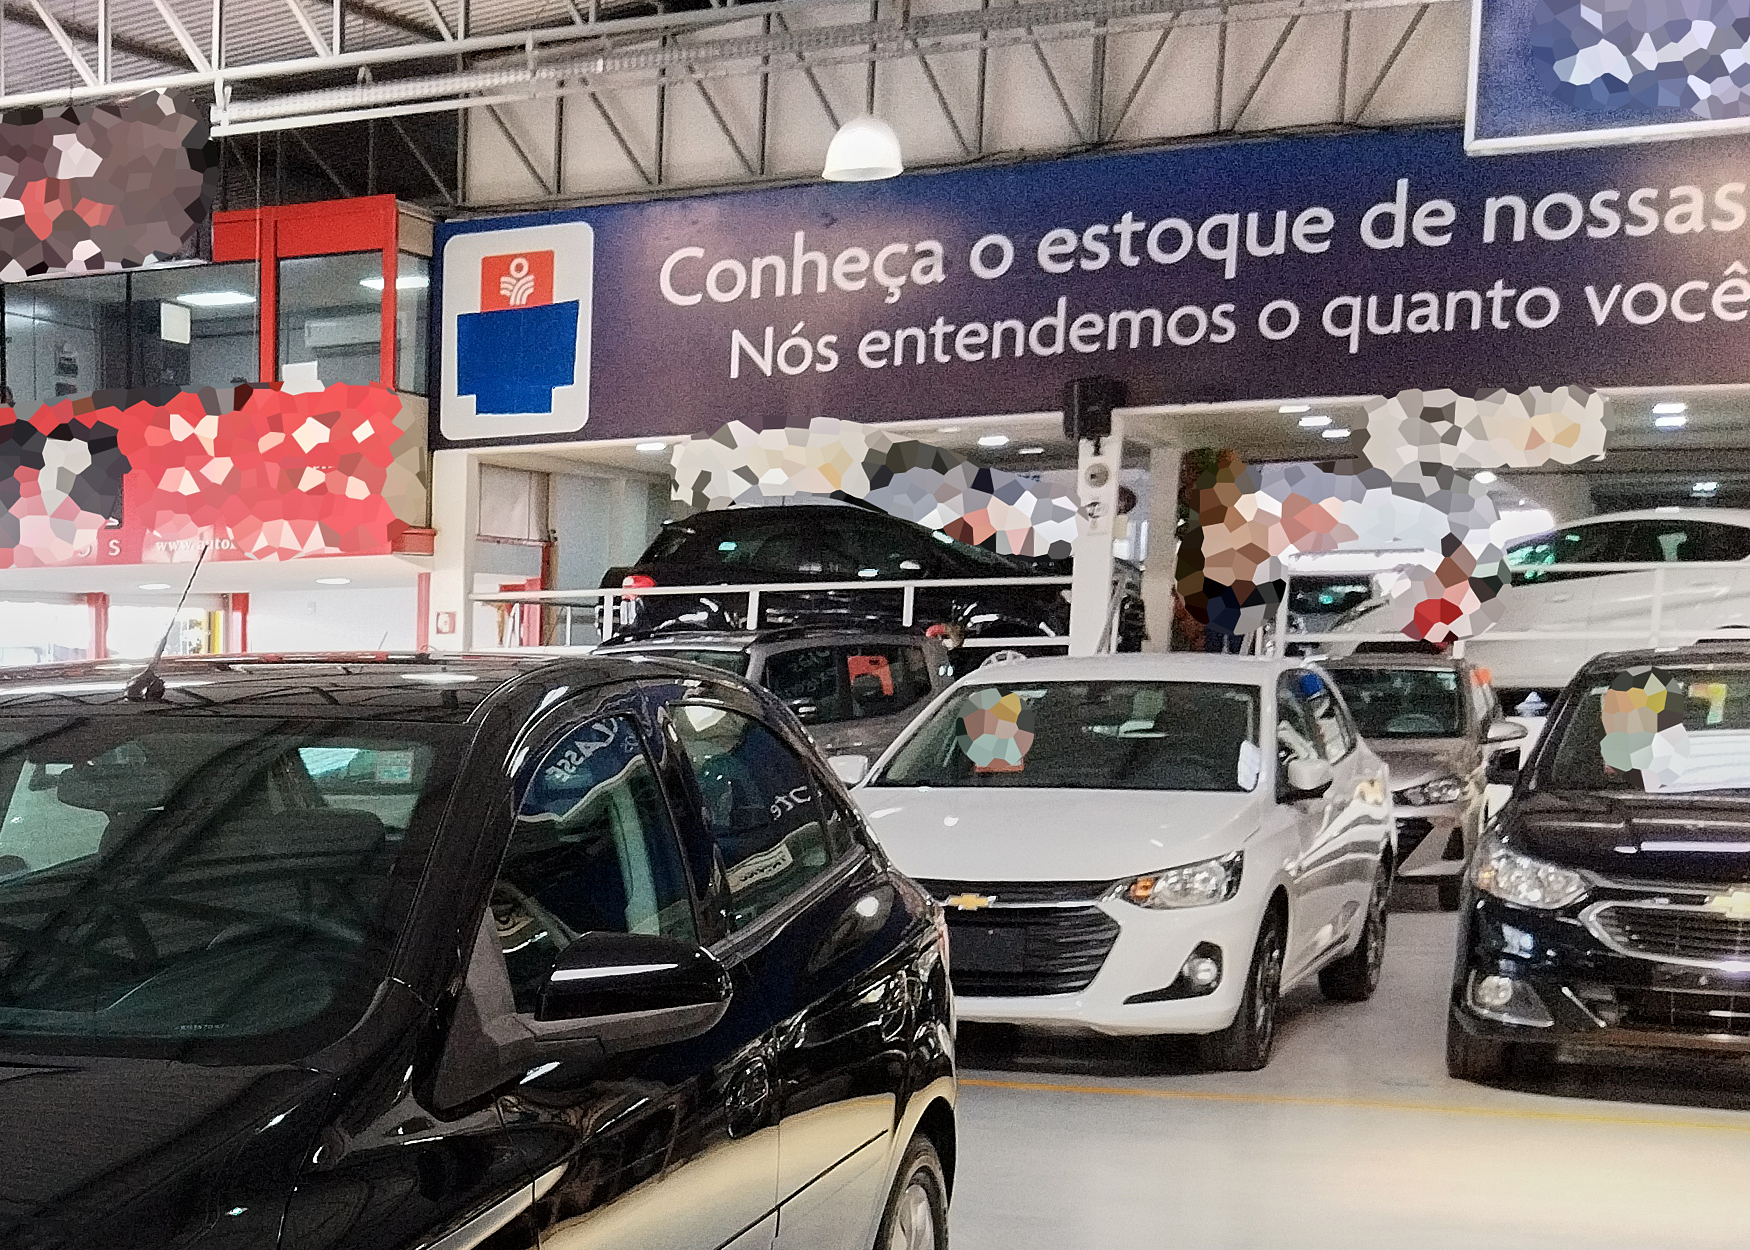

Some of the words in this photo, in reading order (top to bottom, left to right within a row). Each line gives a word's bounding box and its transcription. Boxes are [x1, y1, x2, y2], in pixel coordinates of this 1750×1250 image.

[658, 229, 946, 304] Conheça
[969, 234, 1014, 279] o
[1037, 210, 1335, 279] estoque
[1360, 179, 1456, 249] de
[1482, 182, 1747, 243] nossas
[729, 320, 839, 379] Nós
[857, 296, 1236, 369] entendemos
[1258, 300, 1300, 340] o
[1322, 279, 1560, 354] quanto
[1584, 260, 1750, 325] você
